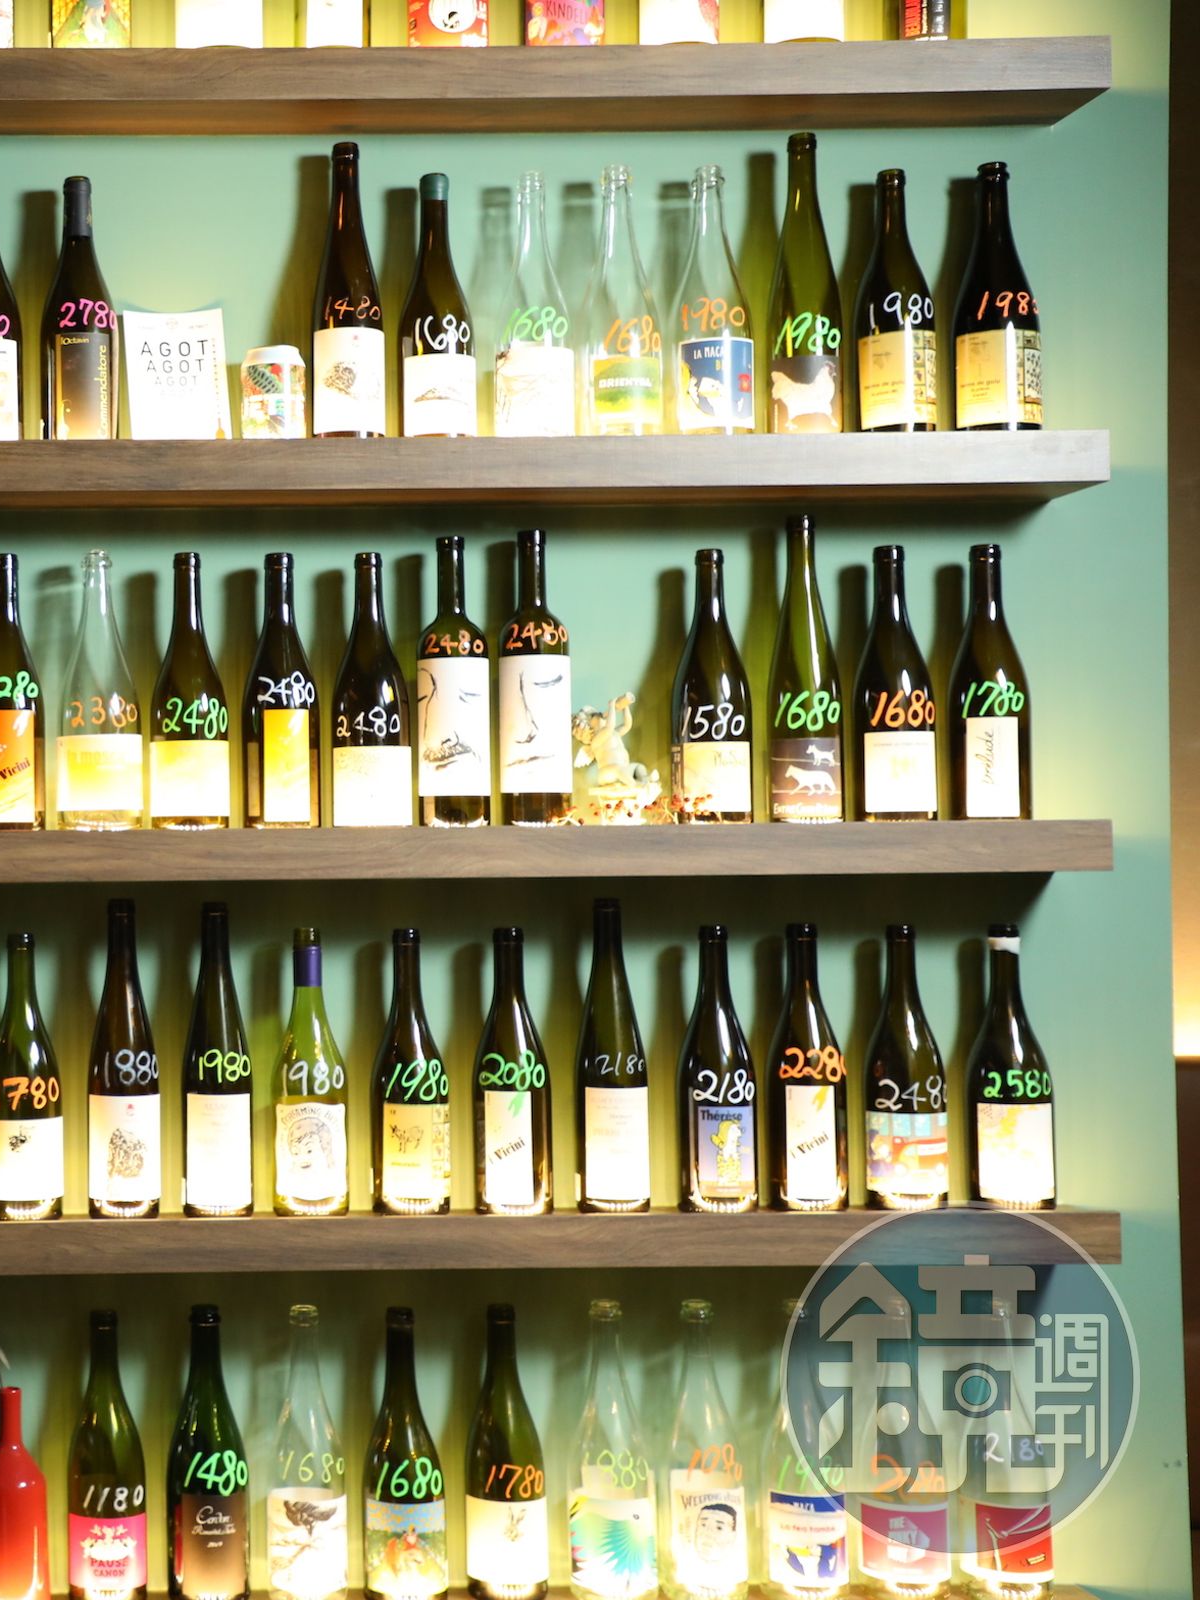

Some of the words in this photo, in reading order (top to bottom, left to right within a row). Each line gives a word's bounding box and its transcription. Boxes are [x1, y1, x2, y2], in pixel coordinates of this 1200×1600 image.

[59, 298, 117, 330] 2780
[324, 296, 381, 320] 1480
[502, 306, 568, 342] 1680
[869, 292, 934, 325] 1980
[141, 339, 208, 357] AGOT
[414, 314, 470, 350] 1680
[147, 359, 204, 373] AGOT
[425, 629, 484, 655] 2480
[506, 619, 568, 650] 2480
[257, 671, 315, 706] 2480
[962, 681, 1024, 719] 1780
[162, 697, 228, 739] 2480
[336, 706, 400, 737] 2480
[680, 702, 745, 741] 1580
[775, 690, 841, 731] 1680
[871, 689, 935, 728] 1680
[103, 1049, 159, 1087] 1880
[199, 1048, 251, 1084] 1980
[282, 1060, 345, 1096] 1980
[385, 1059, 449, 1102] 1980
[479, 1050, 546, 1092] 2080
[693, 1069, 756, 1103] 2180
[983, 1069, 1052, 1099] 2580
[185, 1450, 248, 1496] 1480
[280, 1450, 344, 1482] 1680
[375, 1457, 441, 1500] 1680
[485, 1464, 543, 1498] 1780
[83, 1485, 143, 1512] 1180
